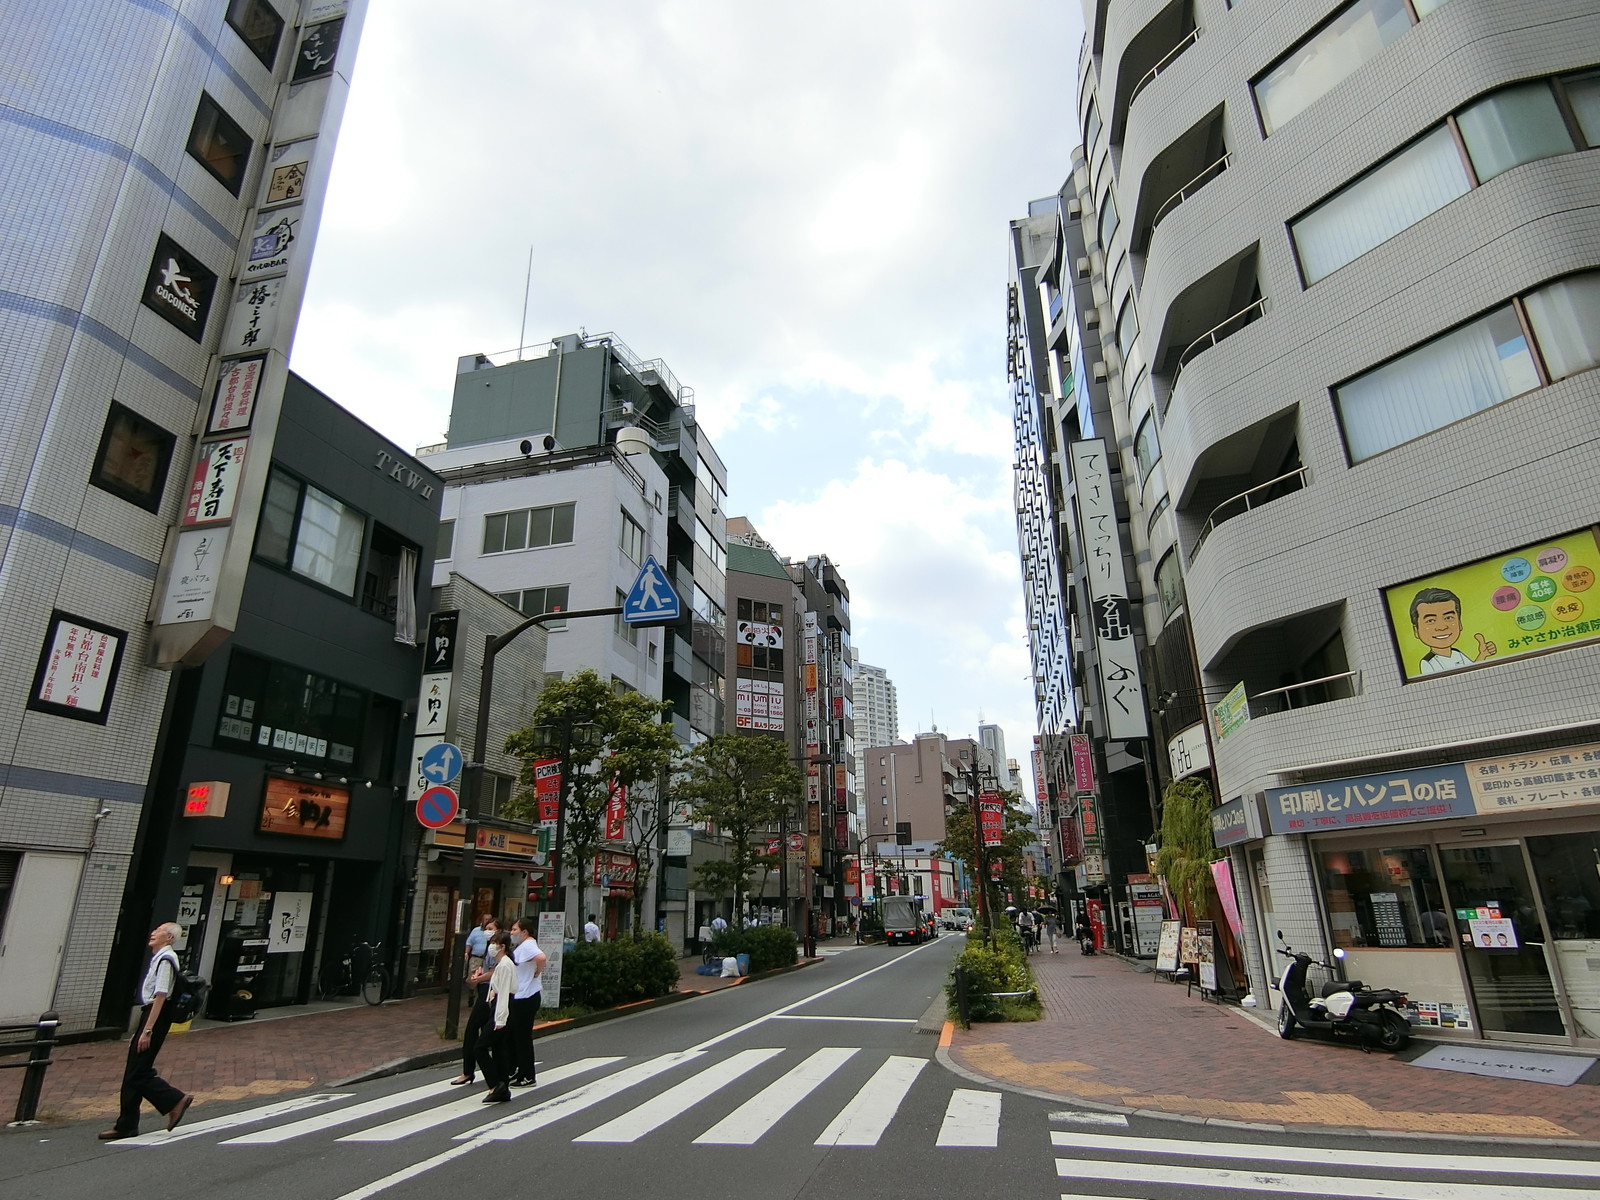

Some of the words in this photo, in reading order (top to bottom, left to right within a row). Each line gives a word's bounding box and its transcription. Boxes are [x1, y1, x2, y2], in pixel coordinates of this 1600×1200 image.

[156, 285, 197, 321] COCONEEL
[204, 443, 233, 517] 天下寿司
[375, 450, 423, 490] TKW
[187, 480, 203, 517] 池袋店
[1503, 562, 1528, 574] スポーツ
[1538, 553, 1565, 567] 肩凝り
[1529, 580, 1550, 591] 整体
[1531, 587, 1553, 598] 40年
[1496, 593, 1517, 605] 腰痛
[1556, 602, 1579, 615] 免疫
[64, 627, 79, 658] 年中無休
[737, 716, 751, 727] 5F
[1482, 767, 1600, 792] 認印から高級印鑑まで各
[1279, 778, 1458, 816] 印刷とハンコの店
[1081, 798, 1097, 835] 不動産
[489, 833, 505, 848] 松屋
